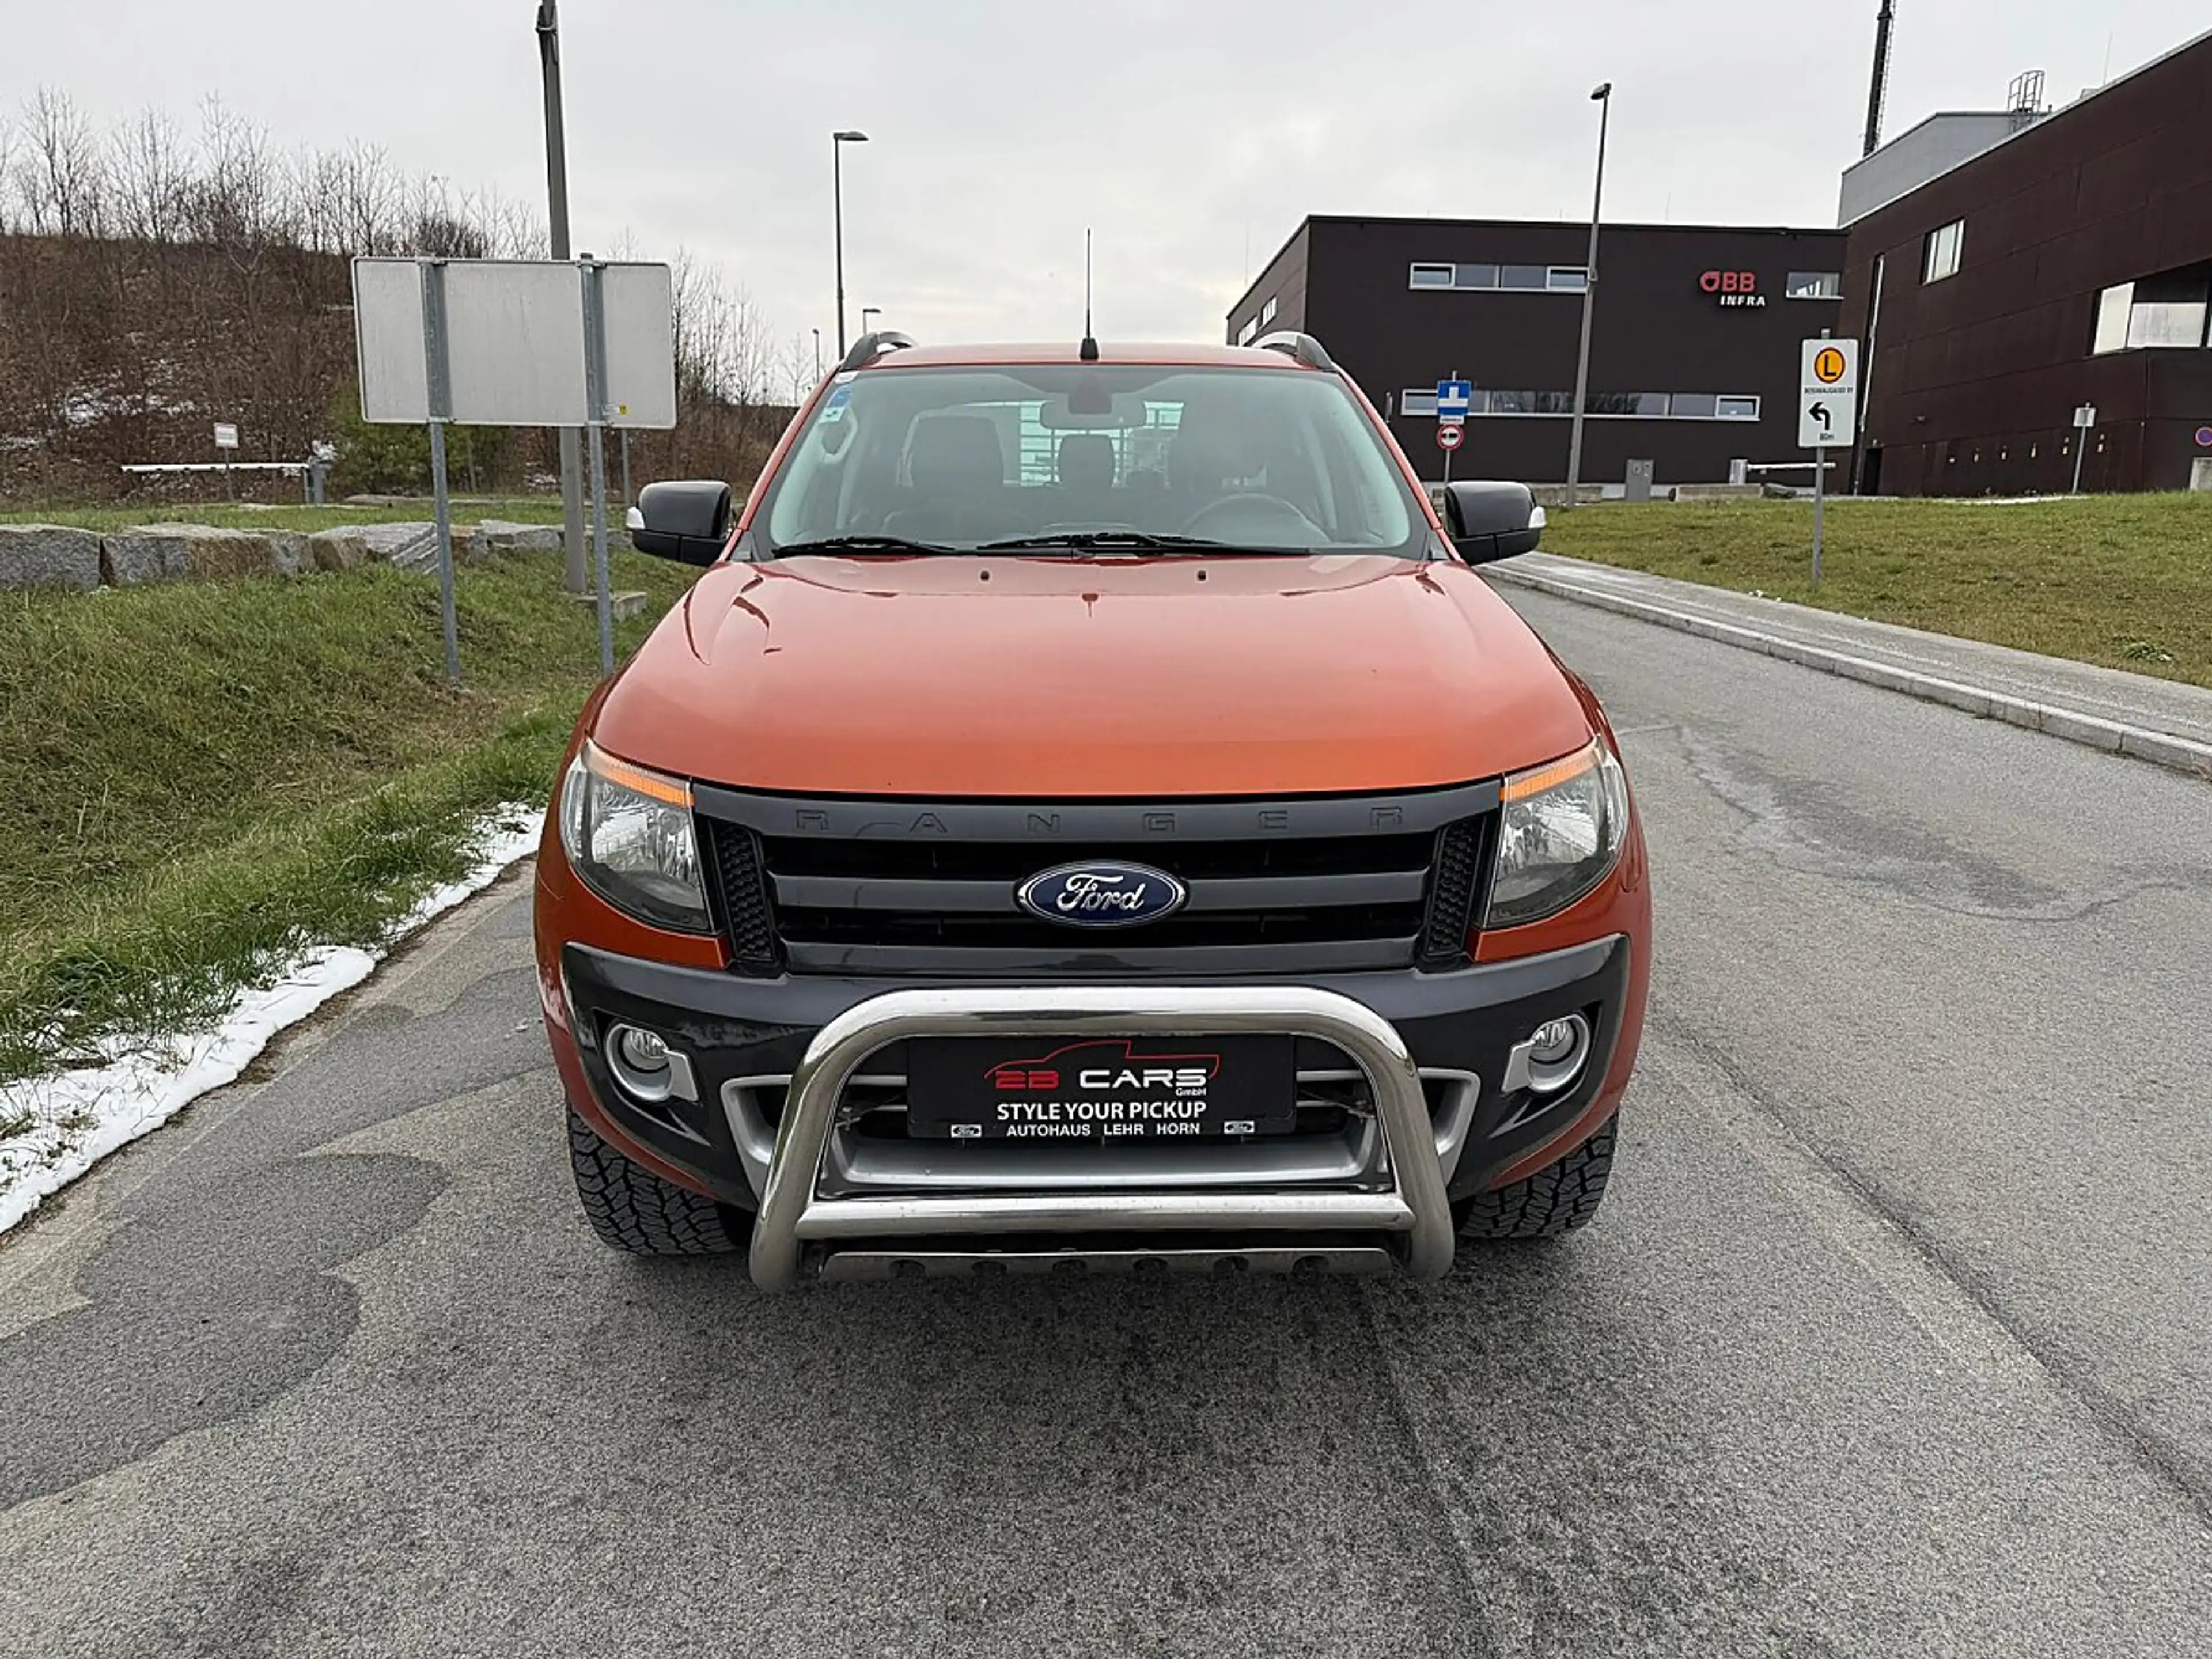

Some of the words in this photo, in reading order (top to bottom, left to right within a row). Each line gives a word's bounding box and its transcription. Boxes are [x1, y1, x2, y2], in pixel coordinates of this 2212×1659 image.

[1719, 294, 1766, 307] INFRA
[1824, 354, 1836, 376] L
[796, 807, 1403, 834] RANGER
[1056, 874, 1145, 911] Ford
[1080, 1069, 1207, 1089] CARS
[997, 1103, 1060, 1120] STYLE
[1066, 1103, 1123, 1120] YOUR
[1130, 1101, 1207, 1119] PICKUP
[1006, 1124, 1090, 1137] AUTOHAUS
[1104, 1124, 1144, 1135] LEHR
[1157, 1123, 1200, 1135] HORN
